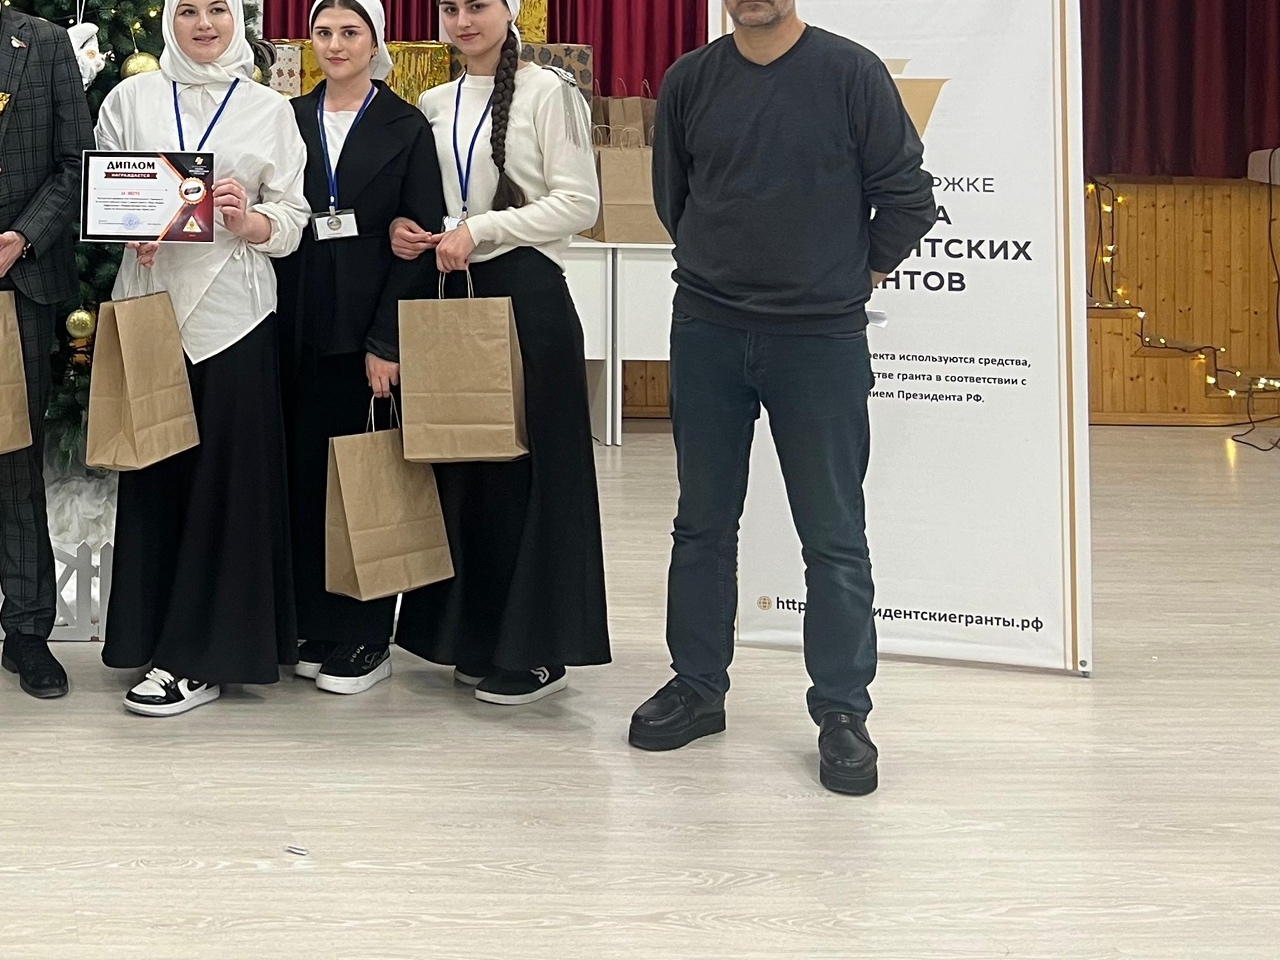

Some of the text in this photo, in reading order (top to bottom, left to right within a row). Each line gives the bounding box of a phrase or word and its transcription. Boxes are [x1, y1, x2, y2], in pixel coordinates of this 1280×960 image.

[106, 161, 155, 170] ДИПЛОМ
[932, 176, 995, 192] РЖКЕ
[914, 238, 1033, 261] ТСКИХ
[875, 270, 966, 292] НТОВ
[872, 352, 1031, 368] екта используются средства,
[897, 373, 933, 382] гранта
[945, 375, 1018, 385] соответствии
[870, 390, 985, 403] ием Президента РФ.
